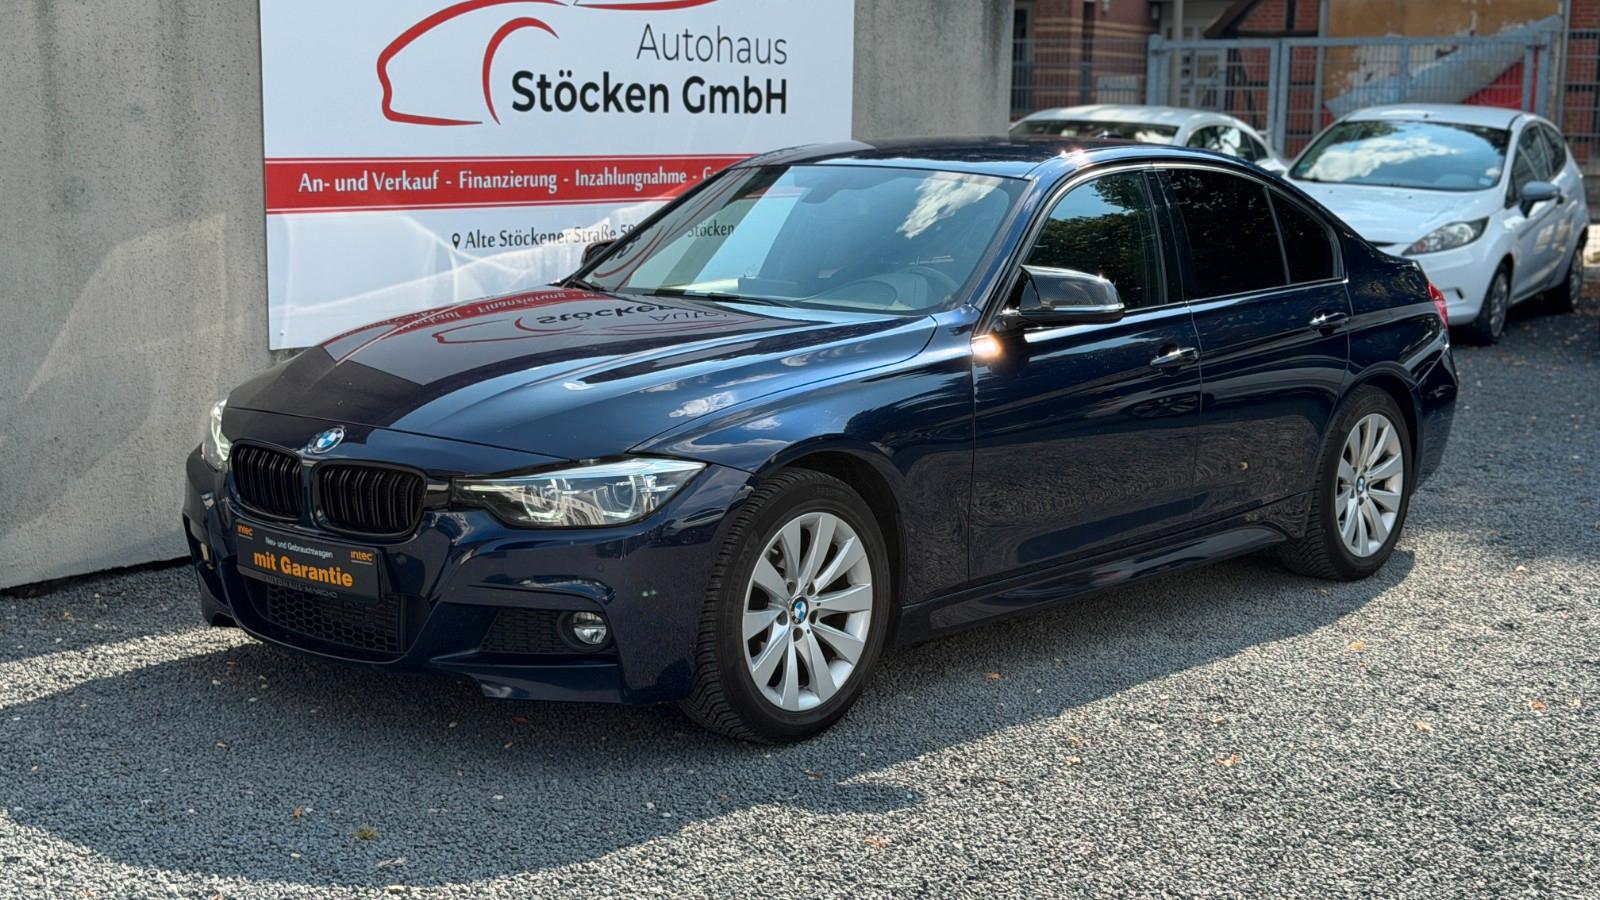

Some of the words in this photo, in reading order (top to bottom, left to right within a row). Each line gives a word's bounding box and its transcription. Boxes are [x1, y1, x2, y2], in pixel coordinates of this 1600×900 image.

[636, 23, 788, 65] Autohaus
[511, 69, 670, 113] Stöcken
[682, 75, 788, 114] GmbH
[298, 172, 331, 193] An-
[334, 169, 369, 192] und
[371, 169, 440, 191] Verkauf
[459, 169, 558, 194] Finanzierung
[575, 166, 688, 192] Inzahlungnahme
[464, 229, 496, 249] Alte
[499, 227, 569, 248] Stöckener
[573, 223, 618, 244] Straße
[253, 551, 278, 571] mit
[280, 555, 353, 588] Garantie
[350, 550, 374, 562] intec
